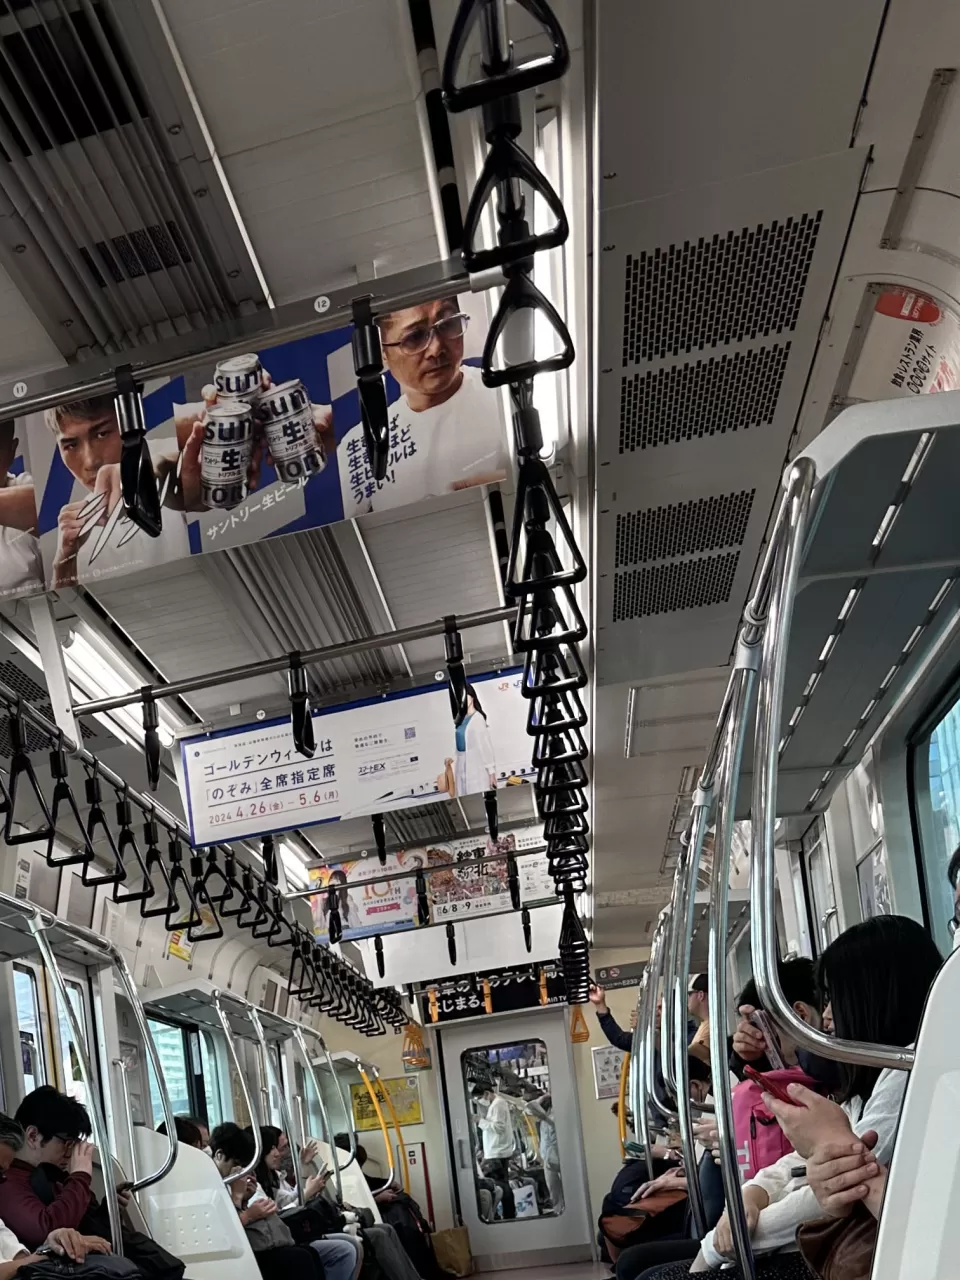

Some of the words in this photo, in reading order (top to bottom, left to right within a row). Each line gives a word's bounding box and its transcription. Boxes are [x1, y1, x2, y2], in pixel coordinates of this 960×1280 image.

[207, 476, 310, 540] サントリー生ビール
[204, 738, 333, 777] ゴールデンウィは
[206, 763, 336, 801] 「のぞみ」全席指定席
[209, 813, 232, 824] 2024
[599, 970, 607, 979] 6
